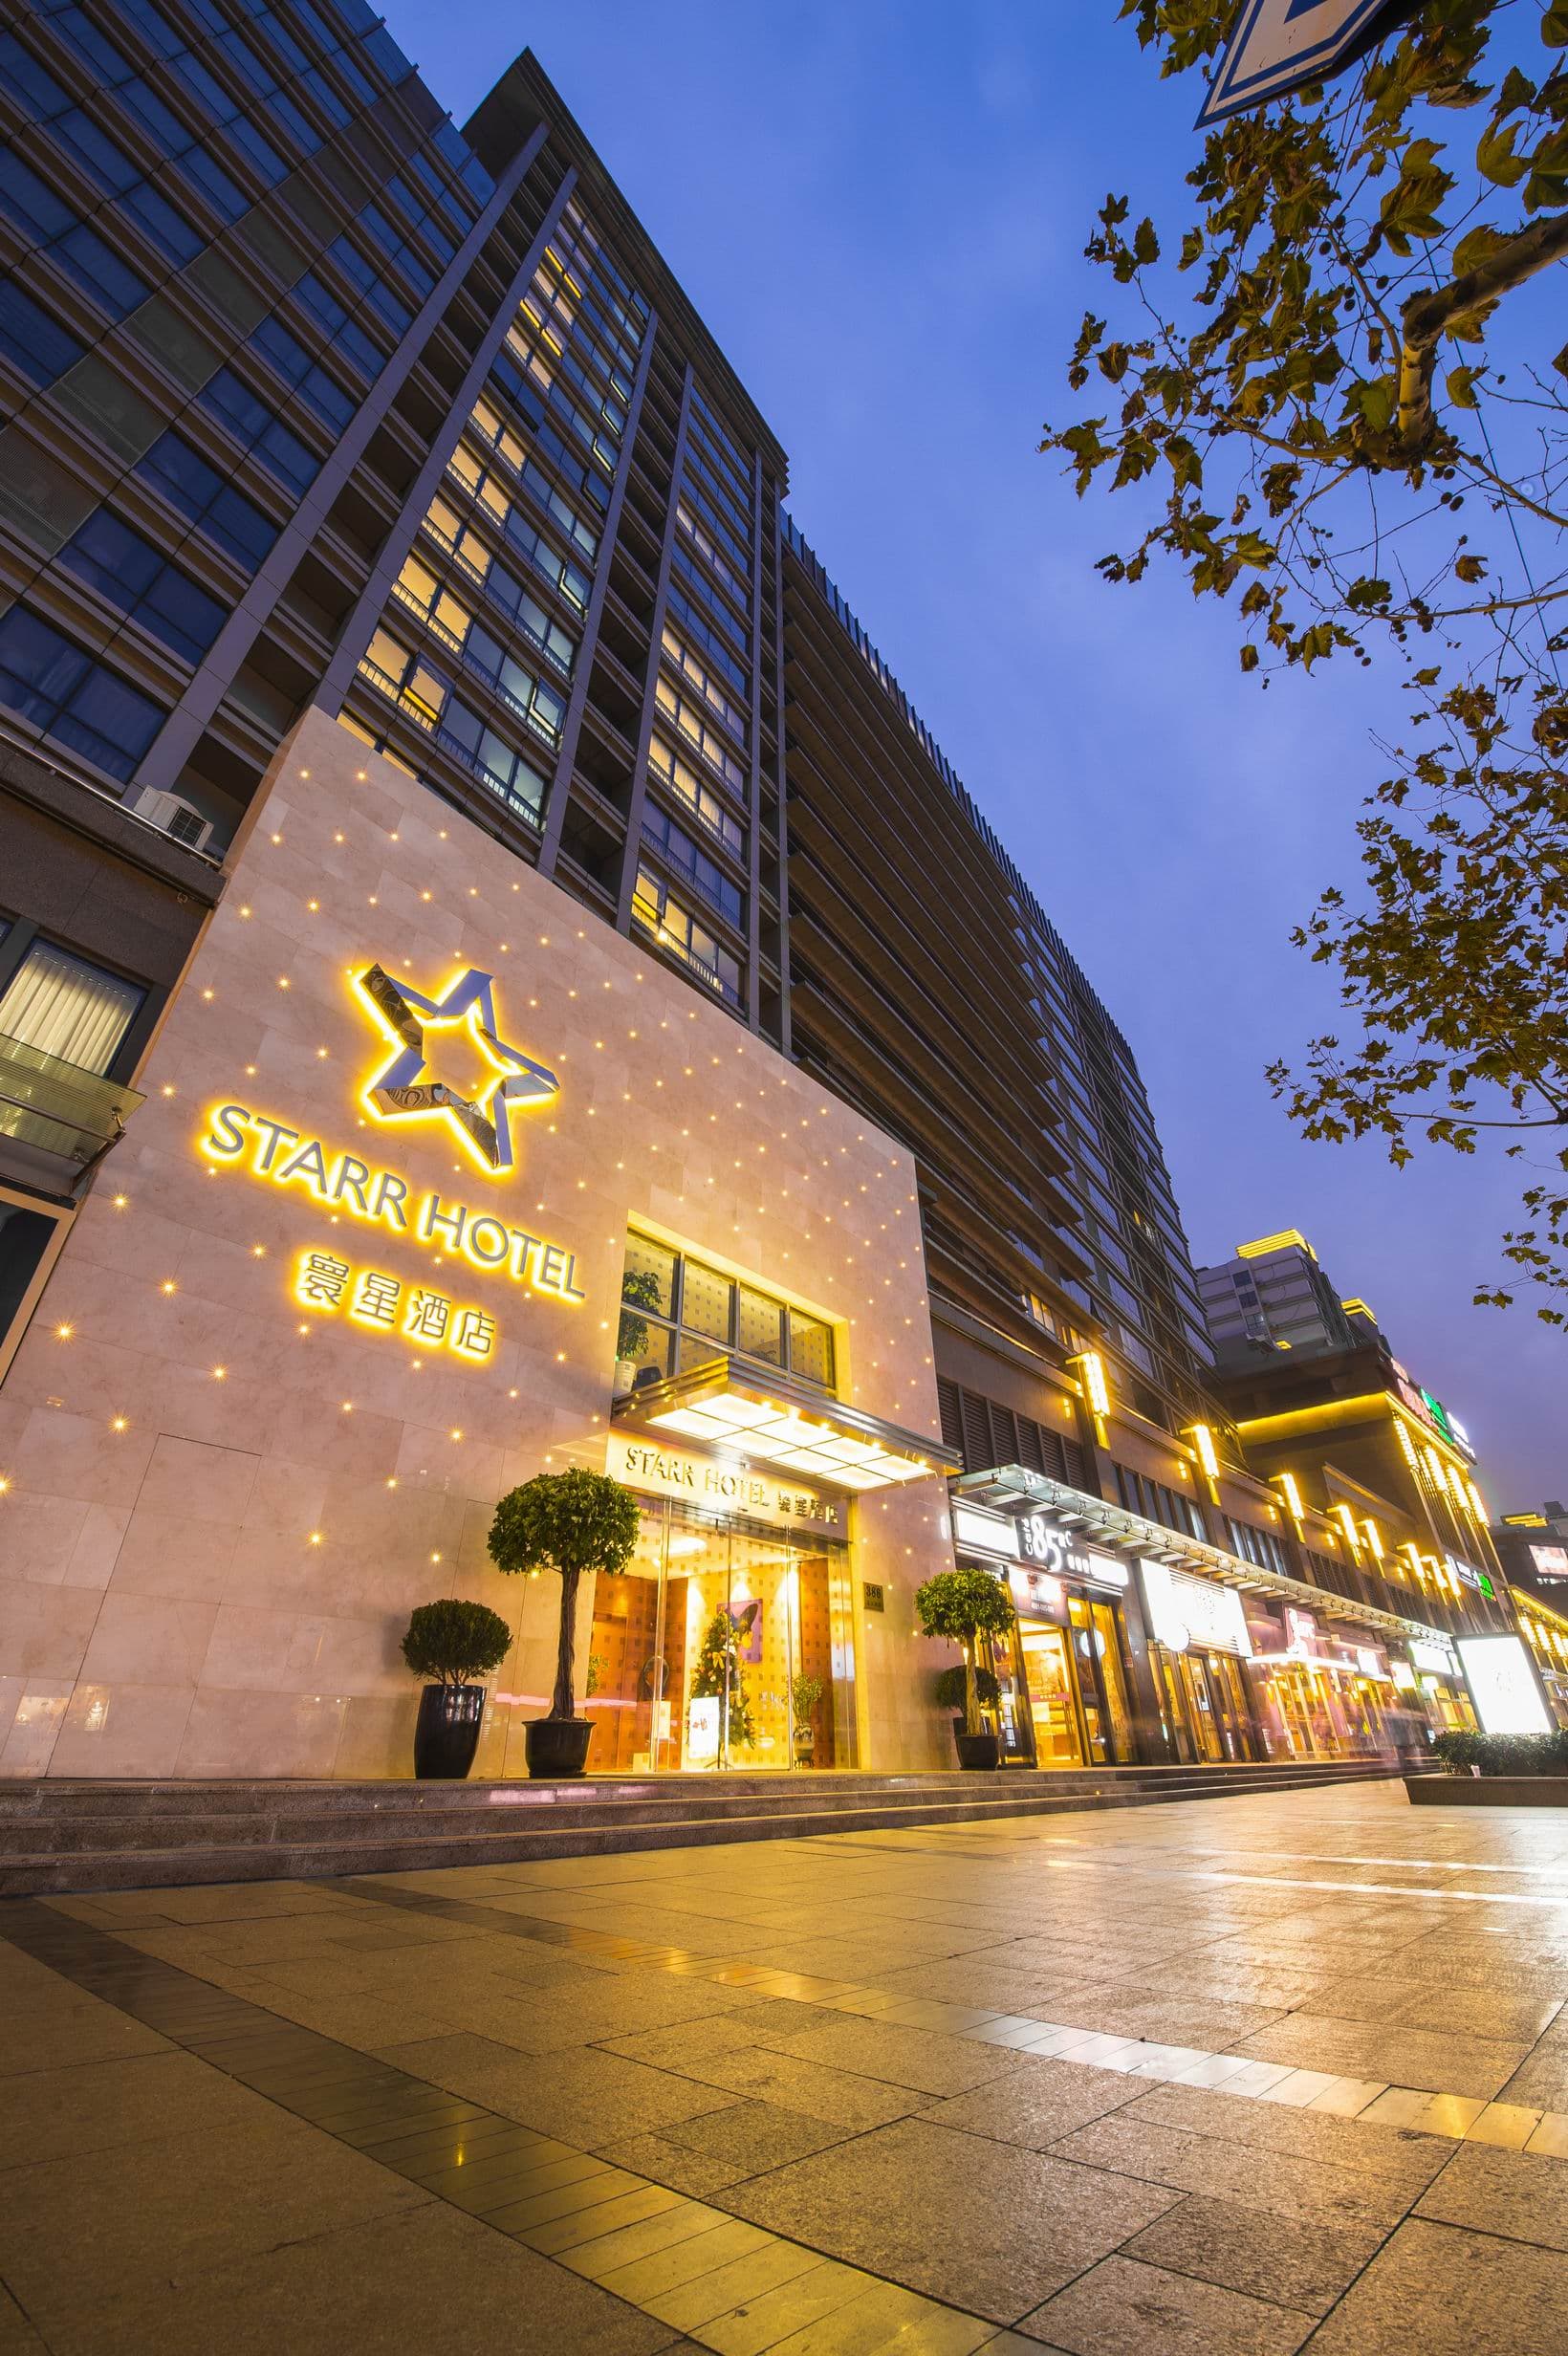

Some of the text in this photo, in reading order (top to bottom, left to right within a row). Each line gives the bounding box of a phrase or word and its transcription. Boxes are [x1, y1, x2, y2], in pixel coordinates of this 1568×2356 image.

[210, 1105, 586, 1298] STARR HOTEL
[298, 1254, 496, 1354] 寰星酒店
[626, 1447, 771, 1507] STARR HOTEL
